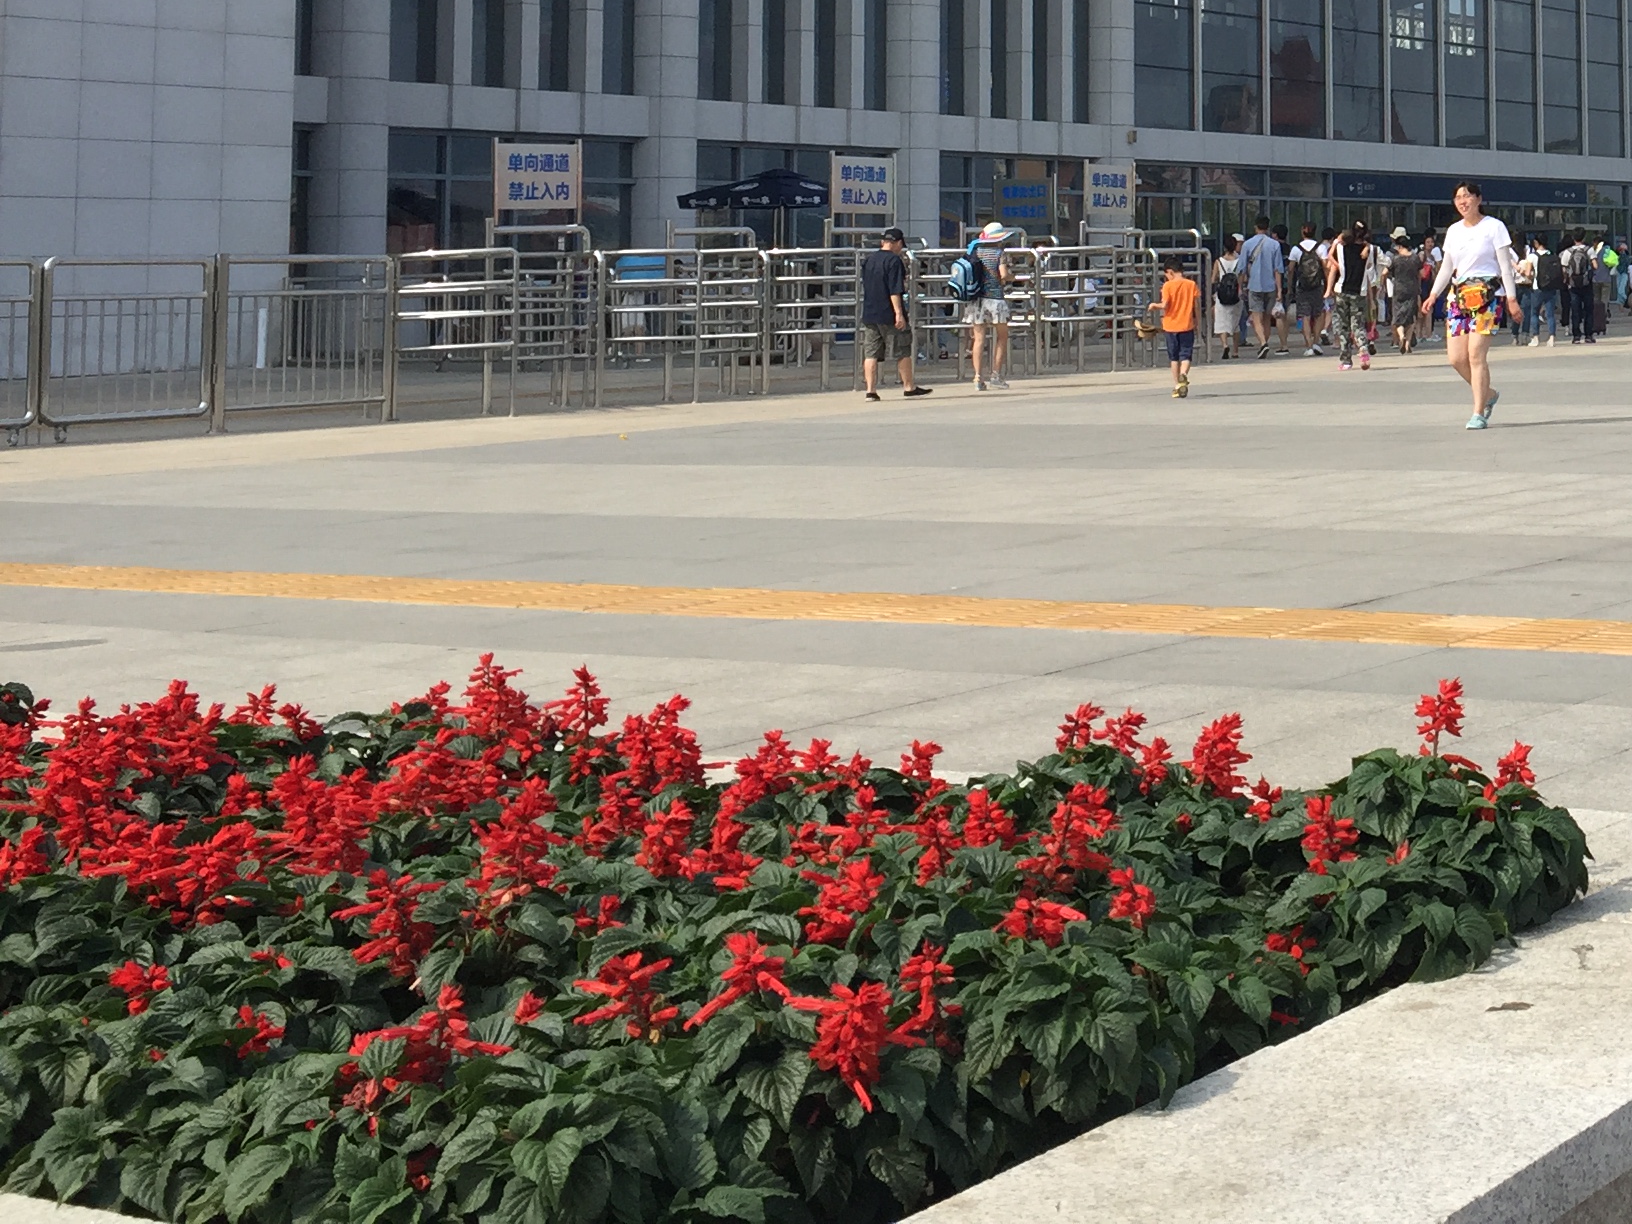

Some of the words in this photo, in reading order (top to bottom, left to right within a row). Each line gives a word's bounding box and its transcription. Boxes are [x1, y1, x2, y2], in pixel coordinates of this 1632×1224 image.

[508, 153, 570, 172] 单向通道
[841, 165, 886, 183] 单向通道
[1092, 173, 1127, 189] 单向通道
[508, 181, 570, 201] 禁止入内
[841, 188, 887, 206] 禁止入内
[1092, 193, 1127, 208] 禁止入内
